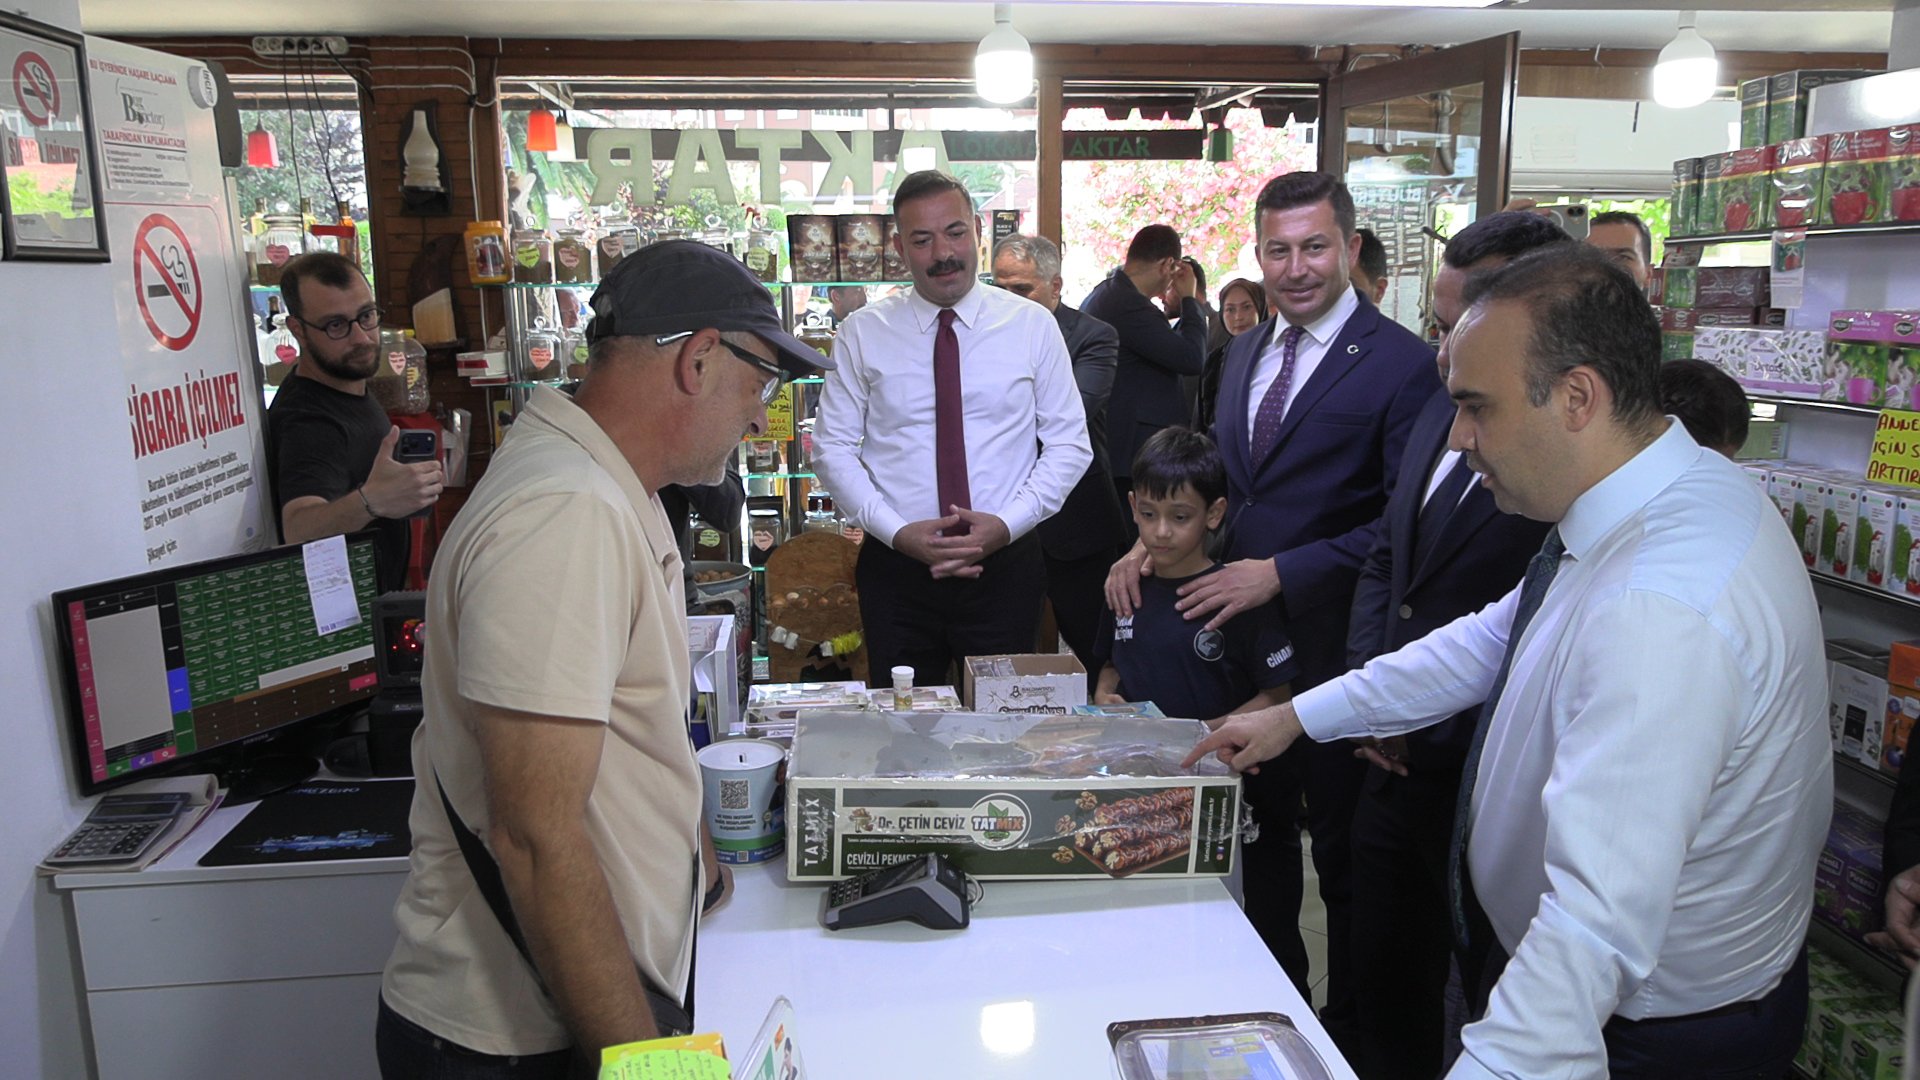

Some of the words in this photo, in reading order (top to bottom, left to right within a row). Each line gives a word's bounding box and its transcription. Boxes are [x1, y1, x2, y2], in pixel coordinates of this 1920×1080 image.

[1069, 136, 1151, 158] AKTAR
[184, 369, 245, 449] İÇİLMEZ
[878, 817, 895, 829] Dr.
[898, 814, 931, 832] ÇETİN
[933, 814, 966, 830] CEVİZ
[847, 850, 880, 866] CEVİZLİ
[882, 853, 916, 866] PEKME
